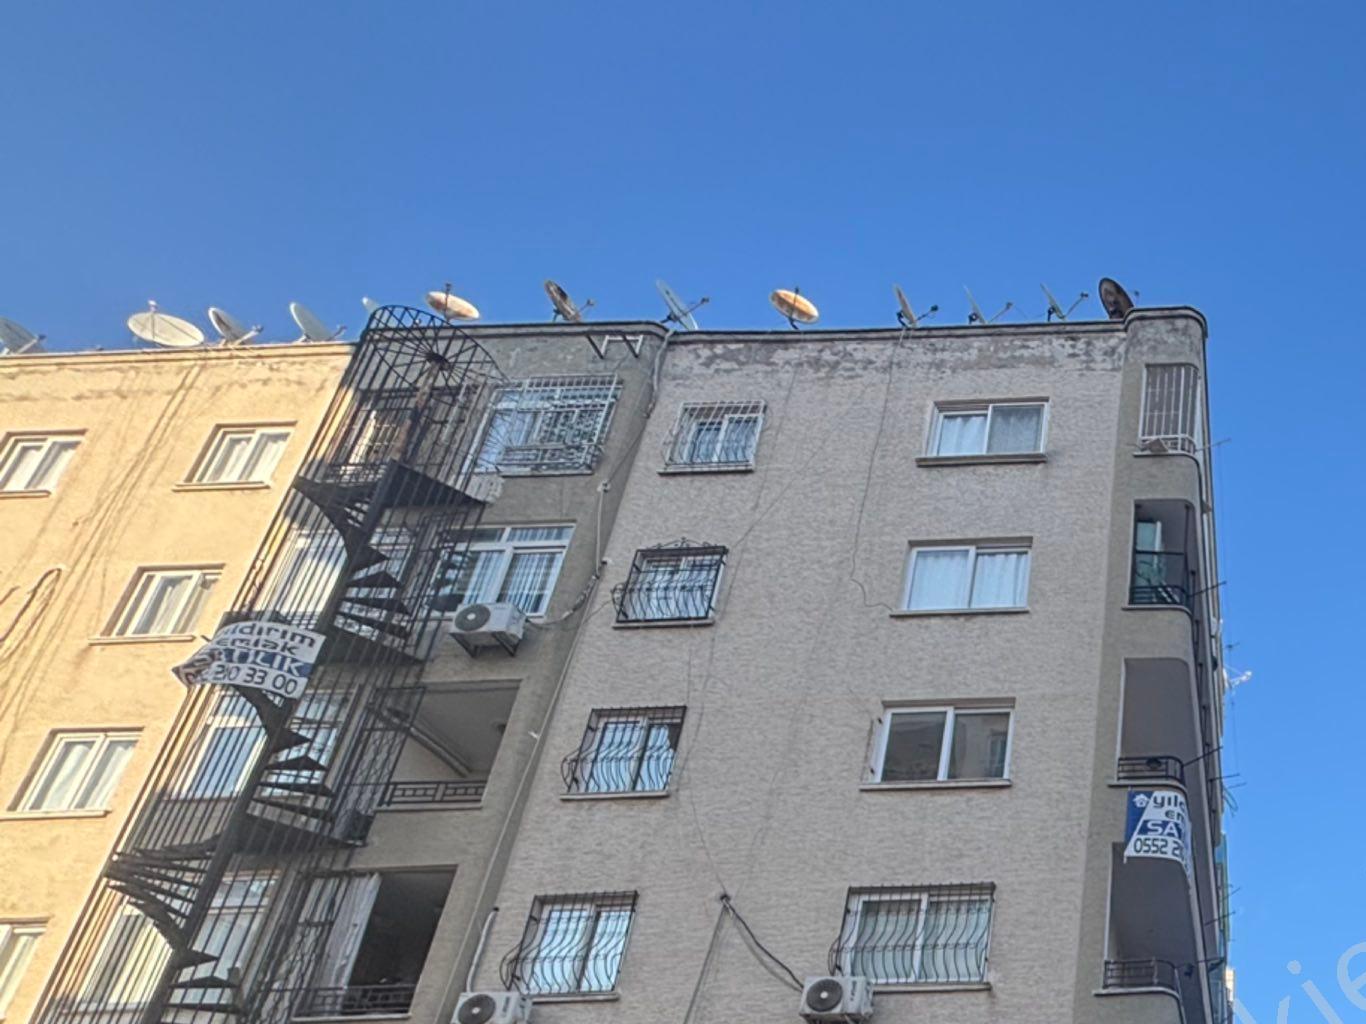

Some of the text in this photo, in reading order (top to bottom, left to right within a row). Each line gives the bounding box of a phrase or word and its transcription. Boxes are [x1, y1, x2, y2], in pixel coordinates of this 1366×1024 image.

[243, 667, 268, 685] 33
[272, 673, 298, 695] 00
[1133, 837, 1168, 854] 0552
